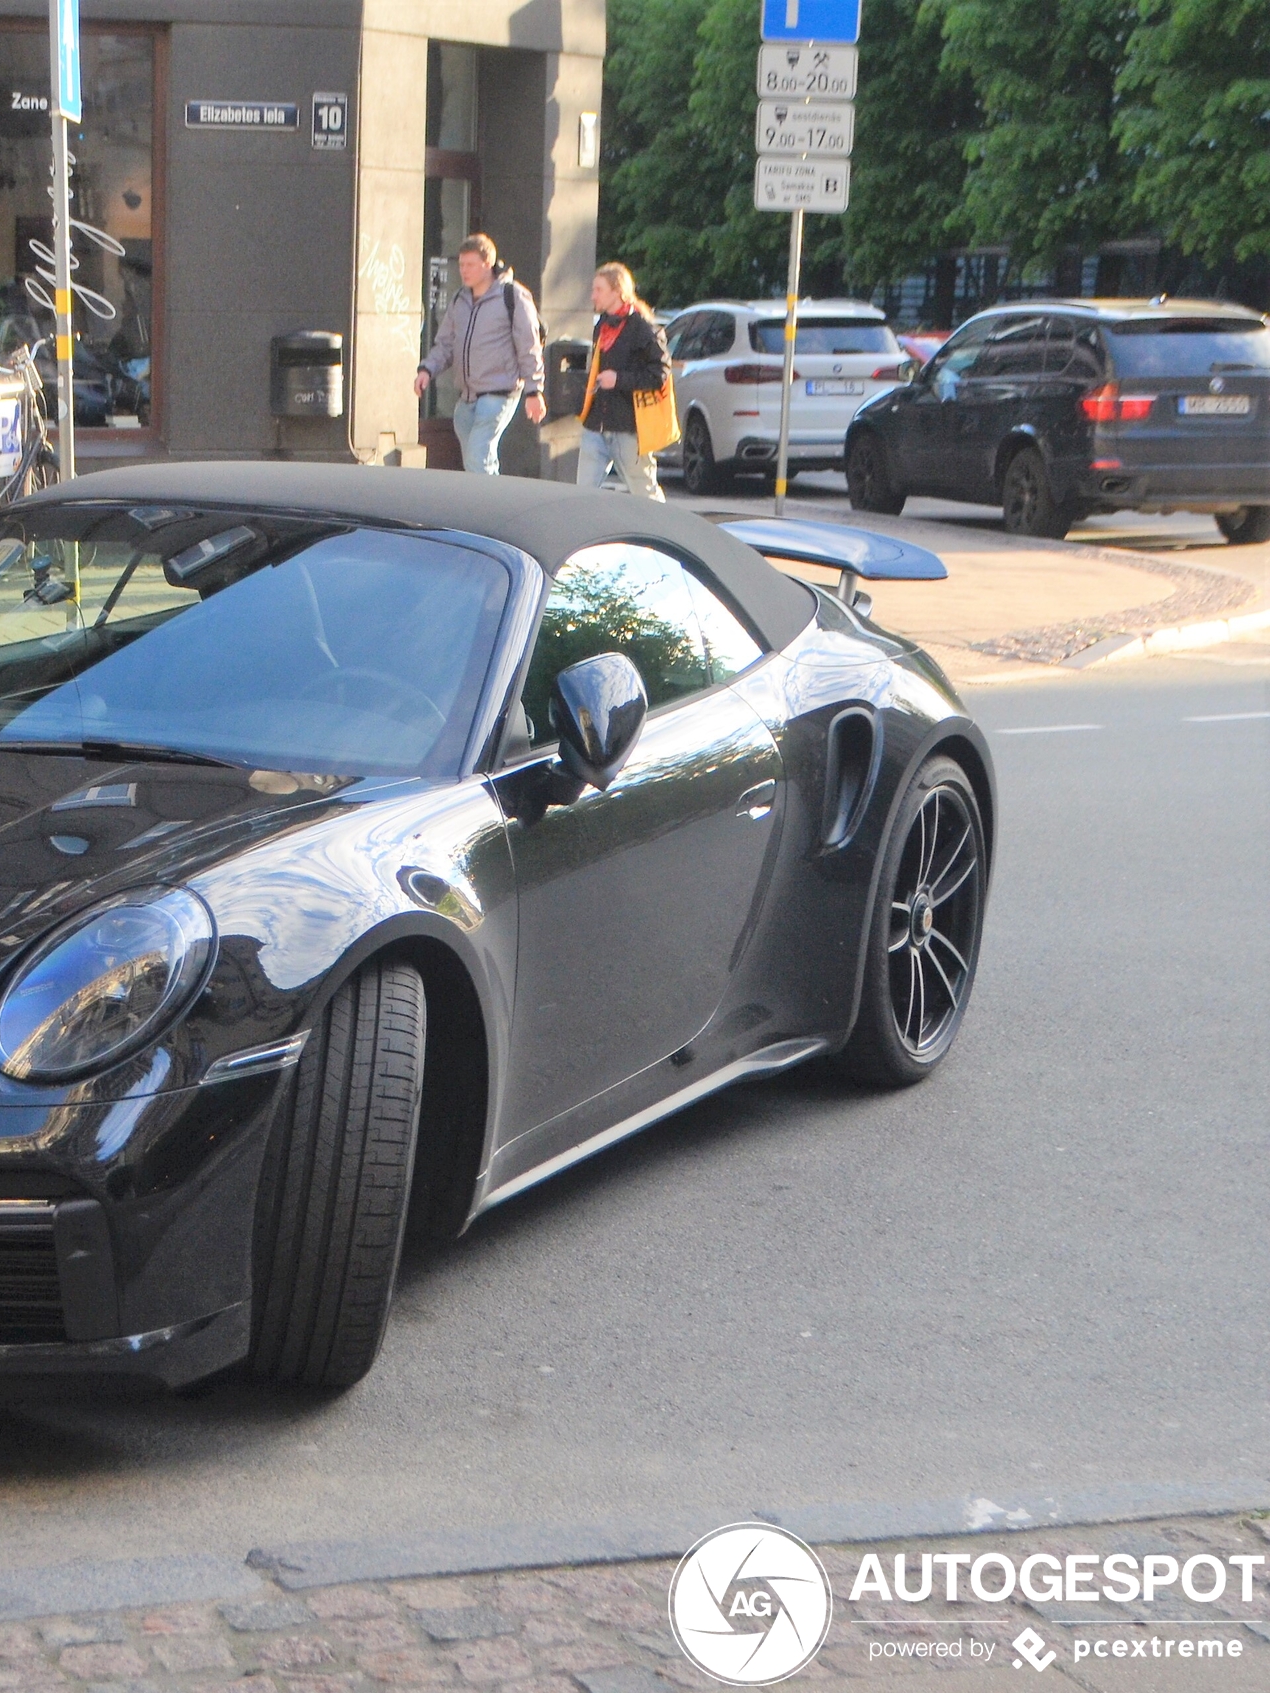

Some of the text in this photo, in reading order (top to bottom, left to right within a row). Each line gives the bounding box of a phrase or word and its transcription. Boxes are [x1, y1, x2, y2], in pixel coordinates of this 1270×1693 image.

[767, 72, 847, 93] 8.00-20.00
[11, 92, 48, 110] Zane
[200, 105, 260, 124] Elizabetes
[318, 105, 342, 130] 10
[766, 127, 844, 149] 9.00-17.00
[825, 178, 837, 193] B
